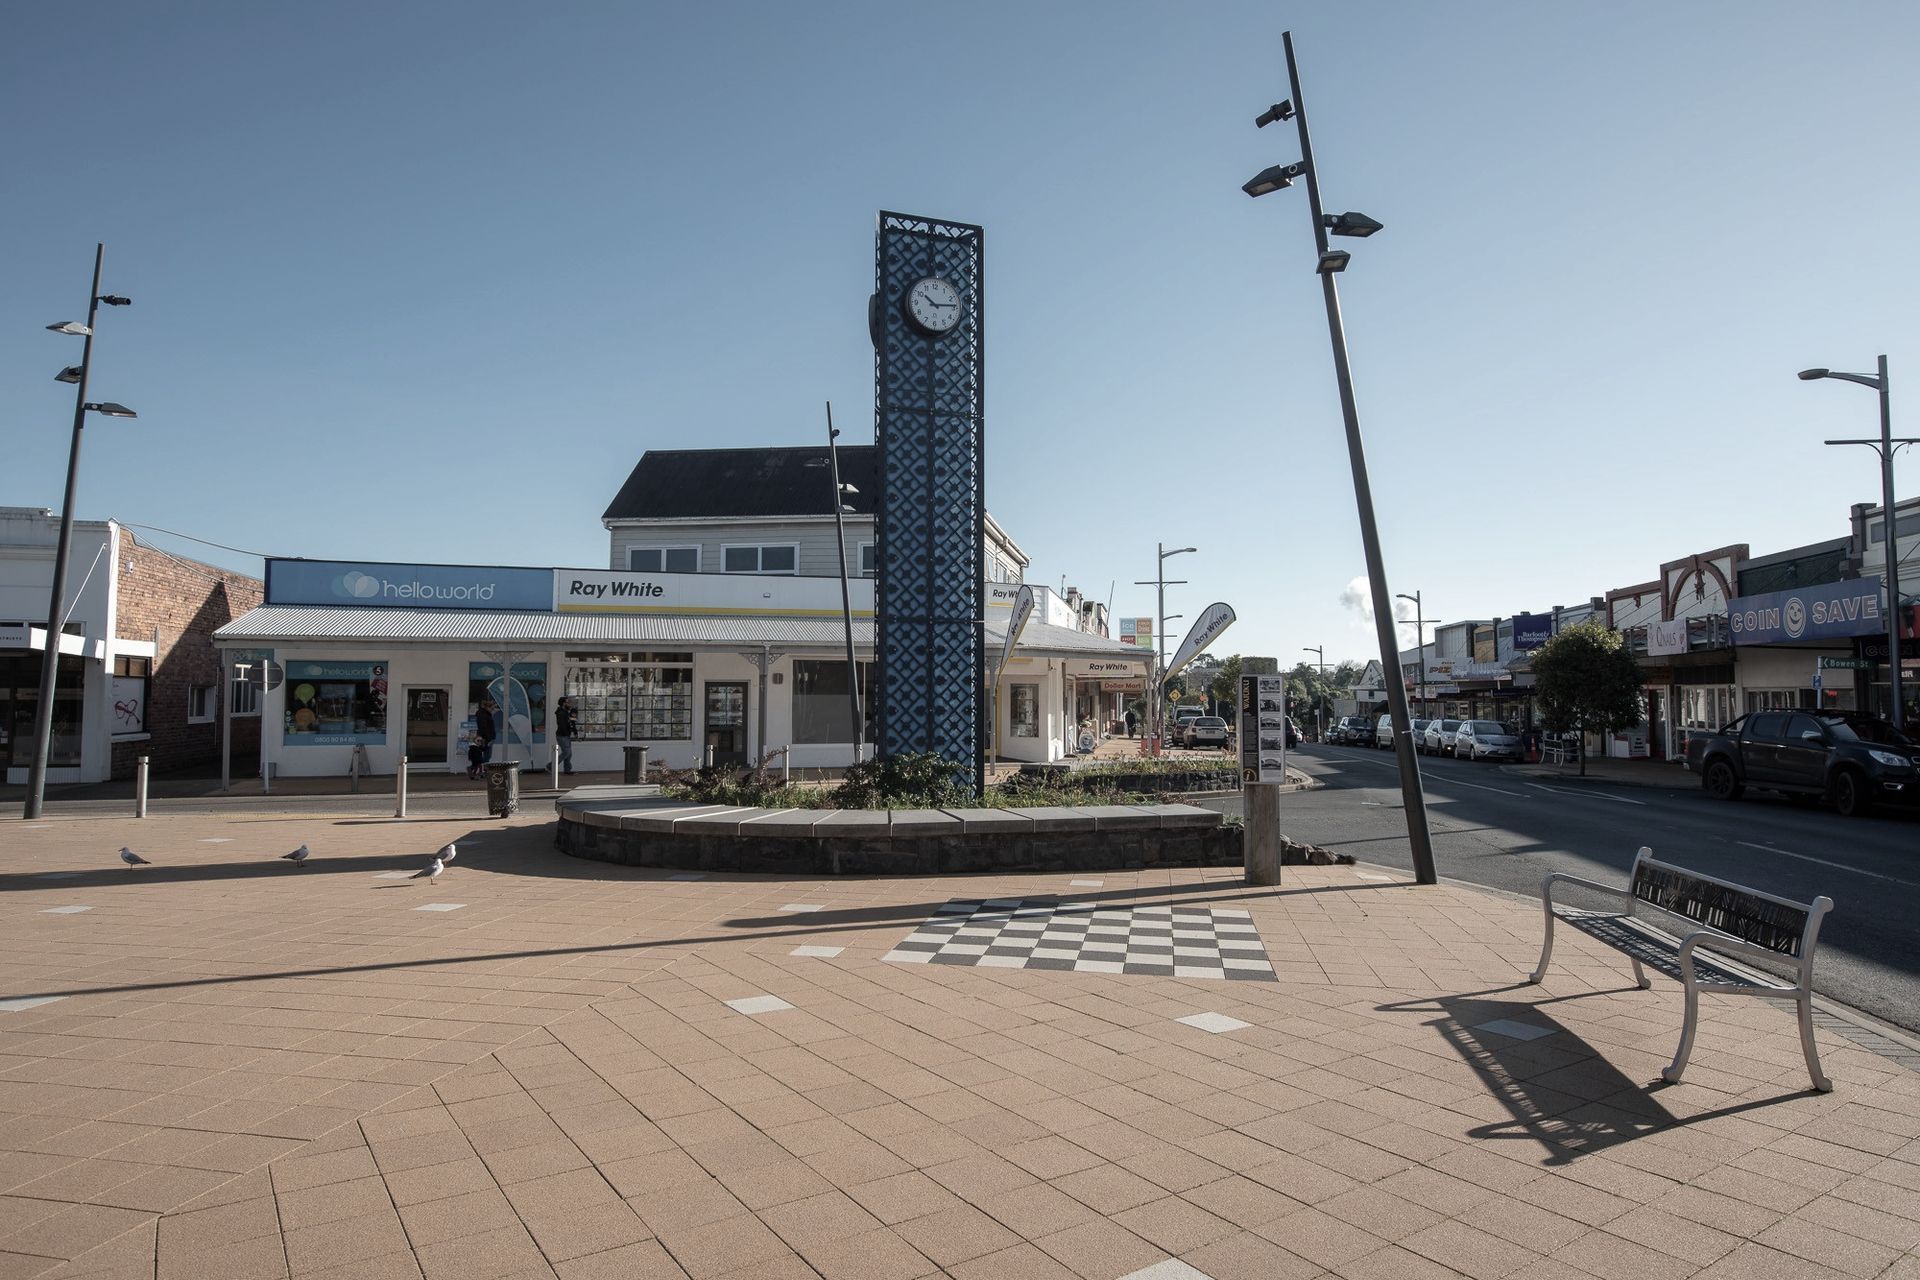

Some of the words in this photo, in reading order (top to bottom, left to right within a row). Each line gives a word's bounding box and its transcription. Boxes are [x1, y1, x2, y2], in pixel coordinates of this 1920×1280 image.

[382, 580, 496, 600] helloworld
[570, 580, 607, 598] Ray
[611, 581, 664, 597] White
[992, 589, 1008, 599] Ray
[1730, 607, 1780, 633] COIN
[1812, 594, 1879, 624] SAVE
[1193, 631, 1210, 647] Ray
[1206, 613, 1228, 633] White
[1089, 663, 1105, 671] Ray
[1105, 663, 1128, 671] White
[1830, 659, 1855, 668] Bowen
